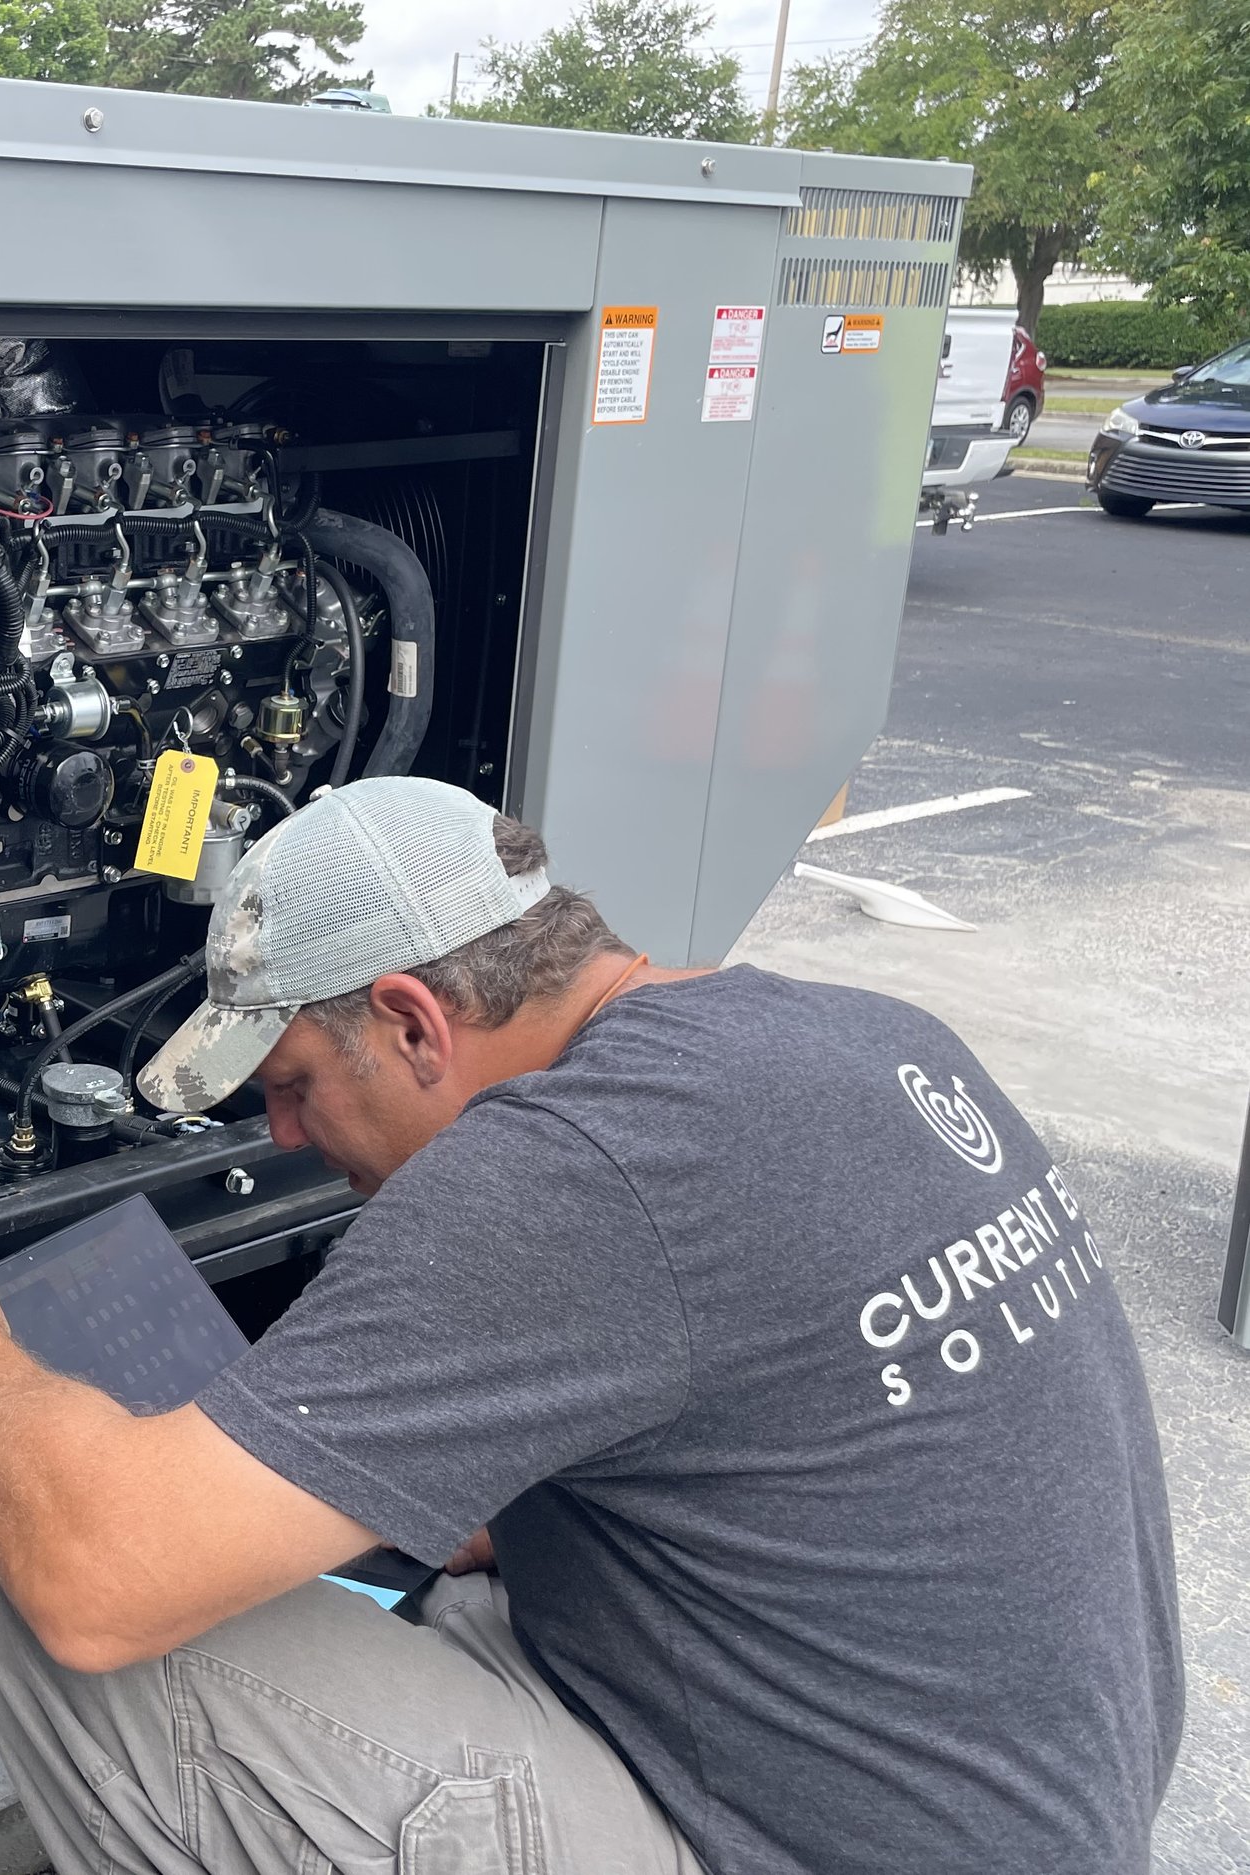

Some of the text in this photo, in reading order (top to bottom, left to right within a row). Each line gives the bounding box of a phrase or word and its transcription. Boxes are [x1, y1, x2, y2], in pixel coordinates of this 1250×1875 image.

[615, 313, 654, 325] WARNING
[728, 309, 758, 320] DANGER
[603, 340, 644, 348] AUTOMATICALLY
[604, 331, 615, 339] THIS
[621, 368, 640, 376] ENGINE
[720, 368, 750, 379] DANGER
[164, 764, 174, 786] AFTER
[159, 789, 169, 815] TESTING
[145, 783, 163, 845] BEFORE STARTING
[164, 805, 172, 821] LEFT
[180, 789, 200, 855] IMPORTANT!
[153, 821, 162, 844] CHECK
[161, 823, 167, 831] IN
[156, 832, 166, 858] ENGINE
[147, 844, 156, 866] LEVEL
[859, 1187, 1060, 1348] CURRENT
